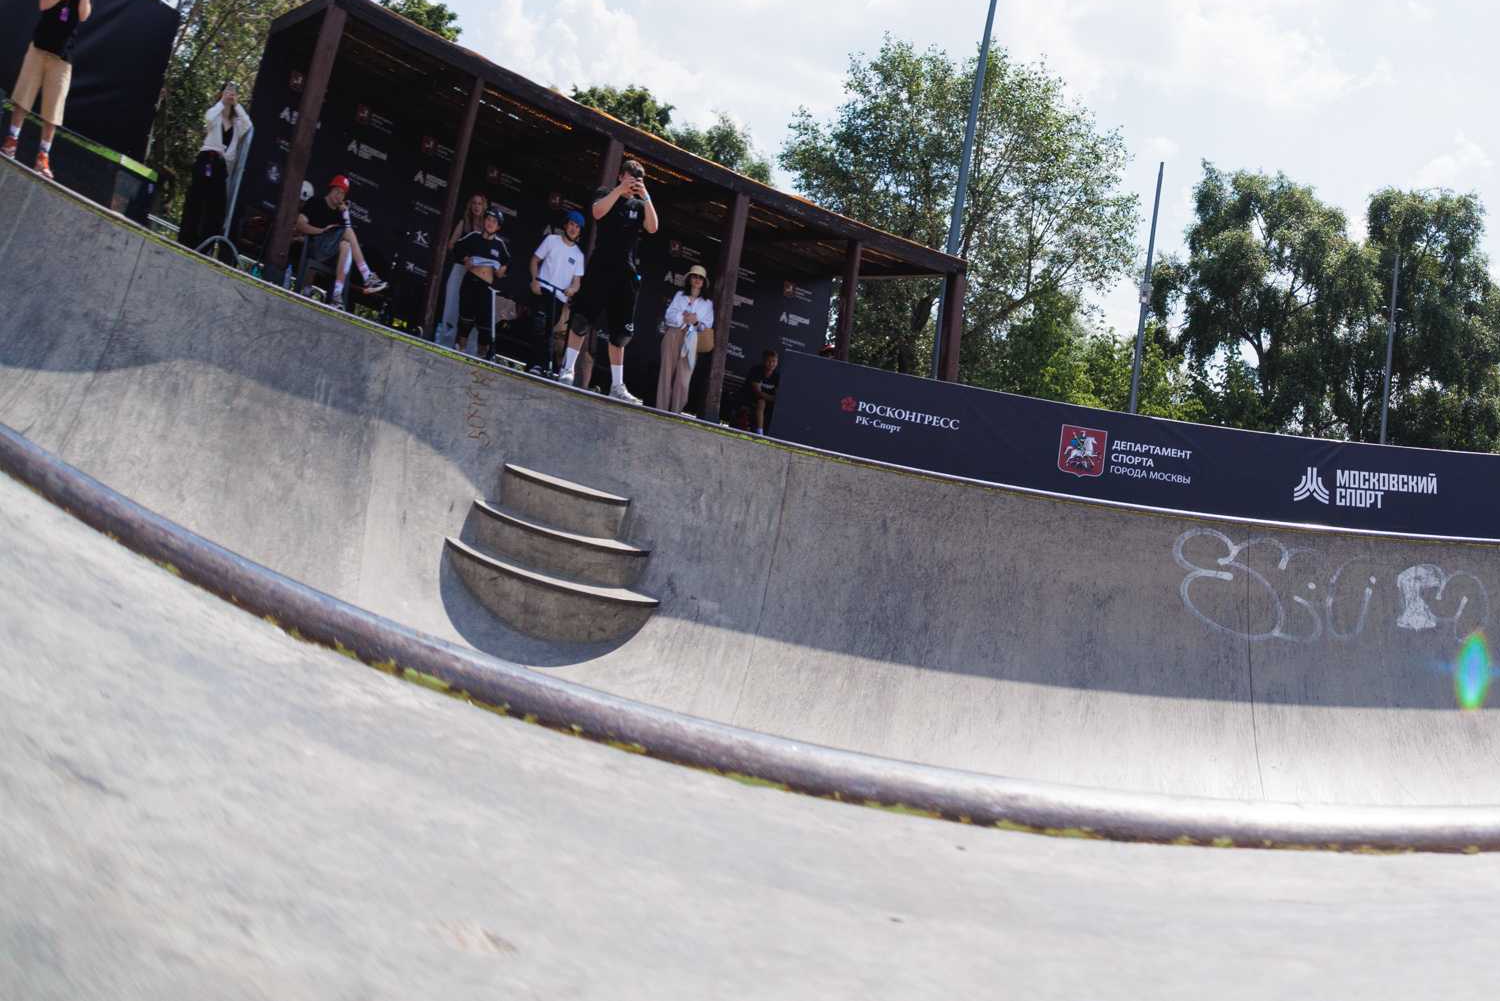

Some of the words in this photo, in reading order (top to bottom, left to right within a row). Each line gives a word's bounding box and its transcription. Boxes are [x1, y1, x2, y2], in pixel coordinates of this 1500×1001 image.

[855, 415, 901, 433] РК-Спорт
[857, 401, 960, 431] РОСКОНГРЕСС
[1112, 440, 1192, 459] ДЕПАРТАМЕНТ
[1111, 453, 1154, 467] СПОРТА
[1110, 465, 1147, 479] ГОРОДА
[1148, 471, 1191, 484] МОСКВЫ
[1336, 469, 1437, 494] МОСКОВСКИЙ
[1336, 487, 1384, 509] СПОРТ
